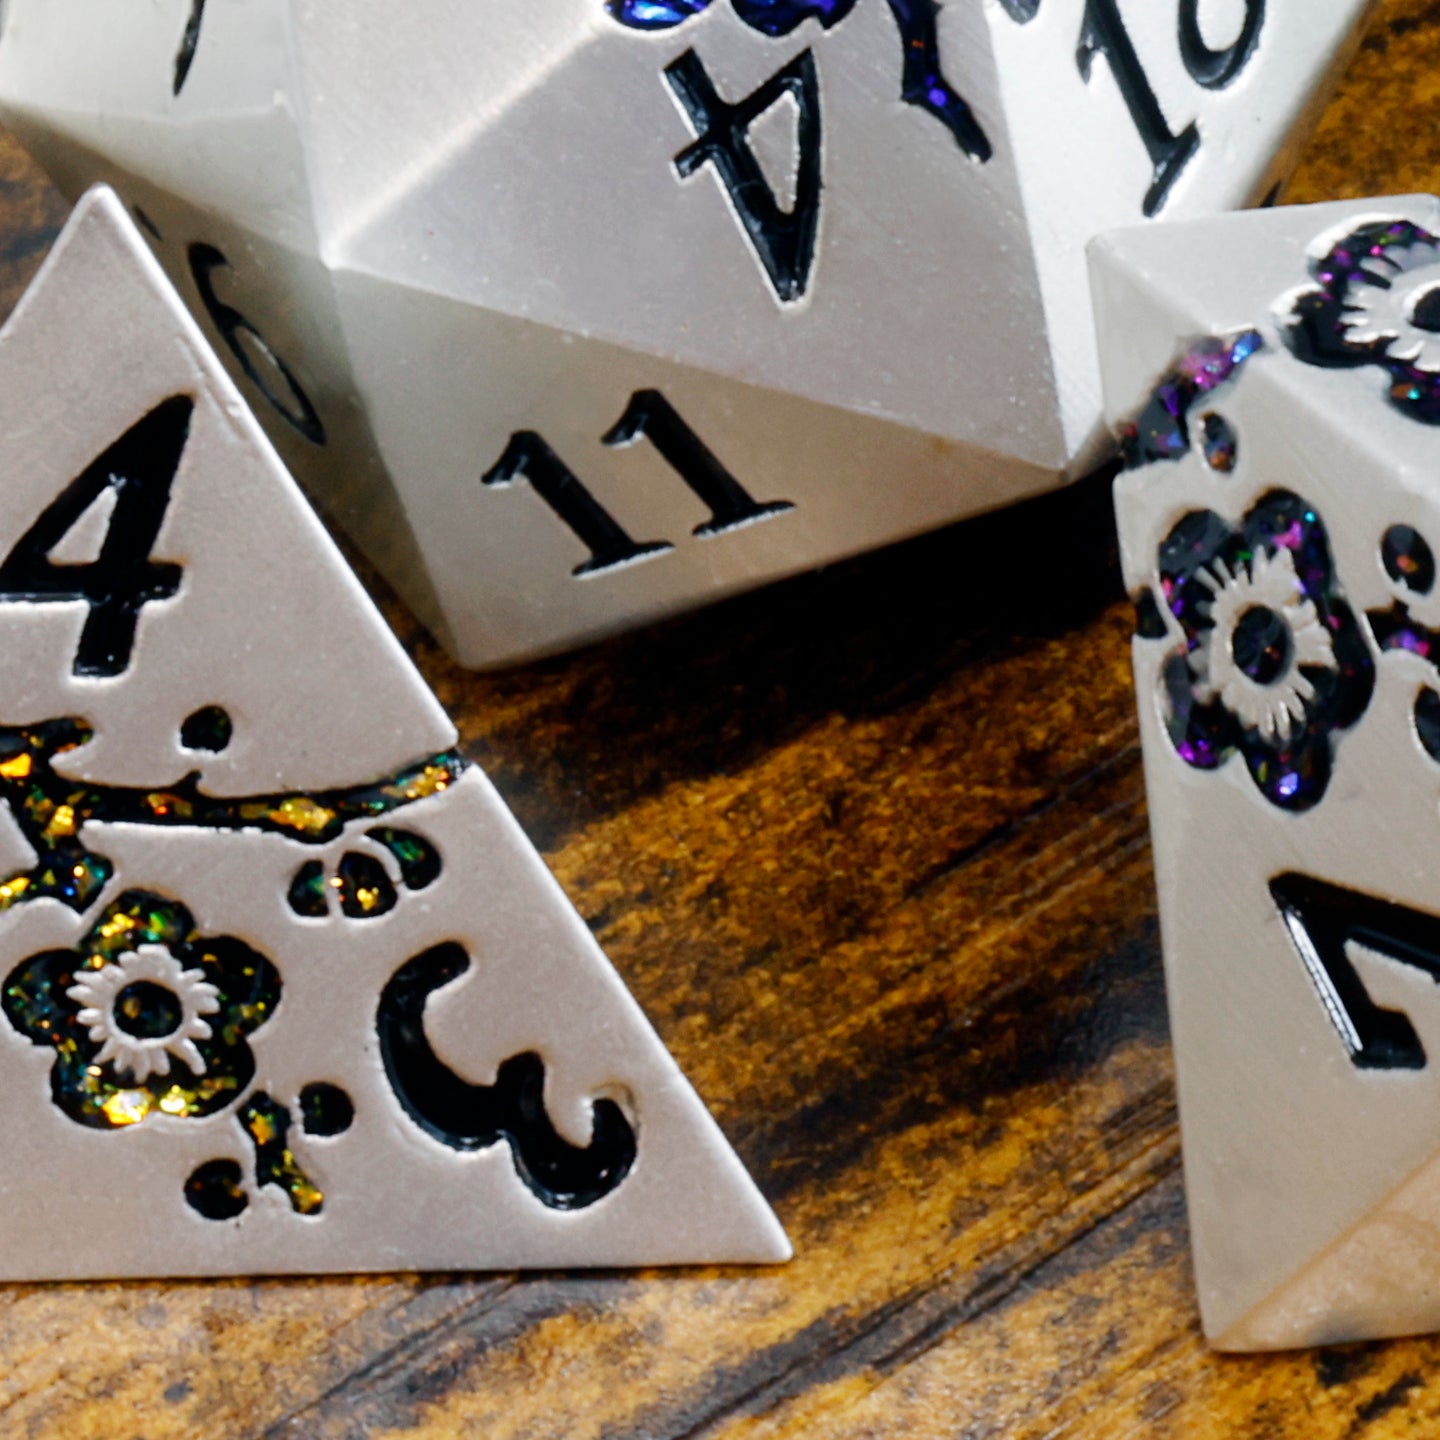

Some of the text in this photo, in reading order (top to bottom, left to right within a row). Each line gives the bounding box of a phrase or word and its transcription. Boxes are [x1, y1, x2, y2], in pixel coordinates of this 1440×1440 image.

[658, 46, 826, 306] 4
[480, 388, 798, 580] 11
[378, 938, 636, 1212] 3
